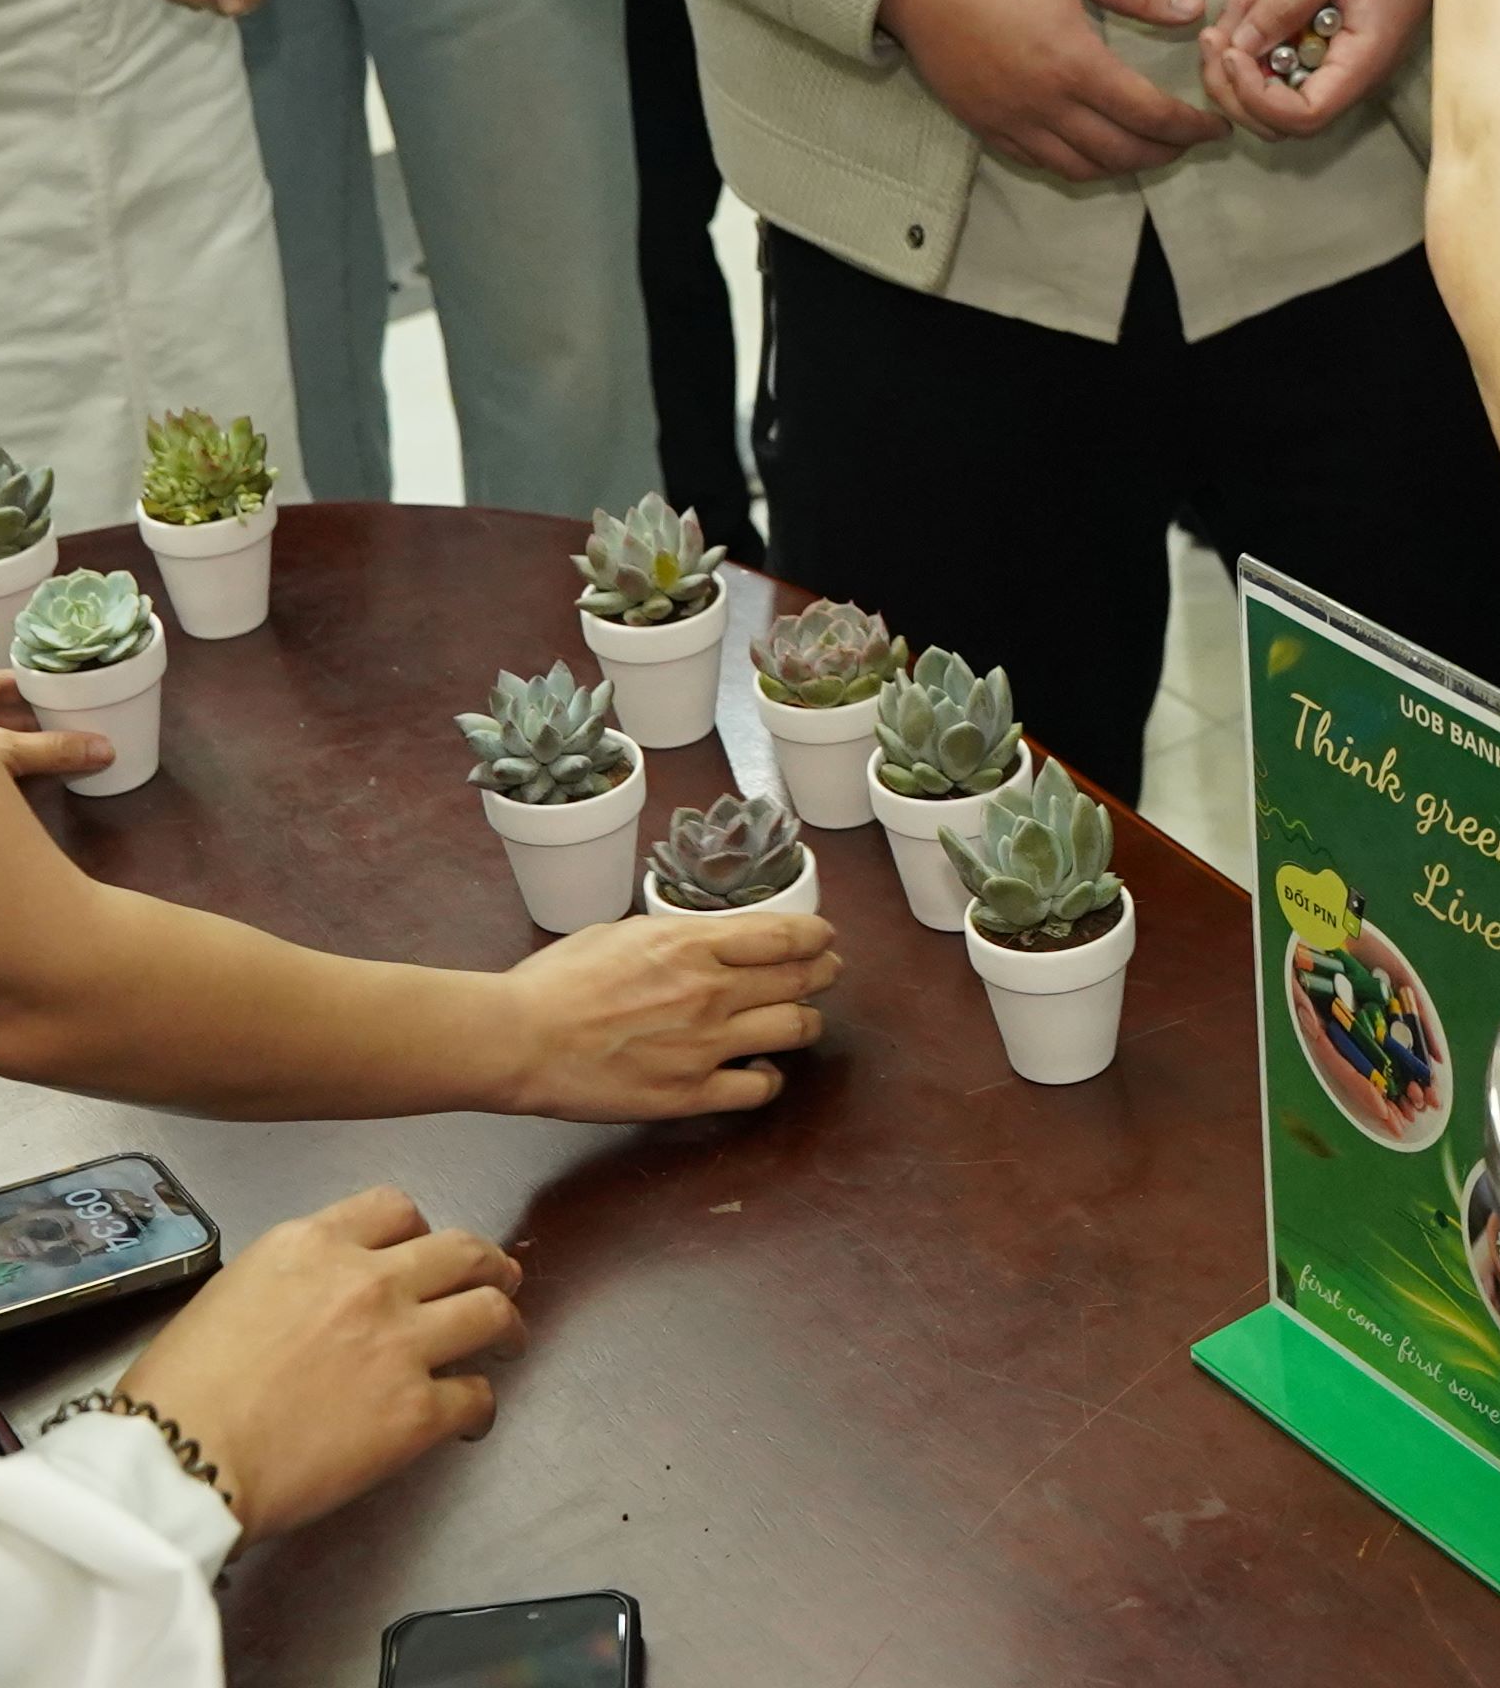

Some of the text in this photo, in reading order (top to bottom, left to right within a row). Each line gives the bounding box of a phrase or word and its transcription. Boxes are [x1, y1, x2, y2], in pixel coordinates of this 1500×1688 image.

[1399, 694, 1445, 736] UOB
[1290, 692, 1405, 803] Think
[1284, 885, 1338, 929] ĐỐI PIN
[65, 1189, 141, 1253] 09:34
[1300, 1264, 1344, 1310] first
[1347, 1306, 1395, 1348] come
[1398, 1336, 1444, 1384] first
